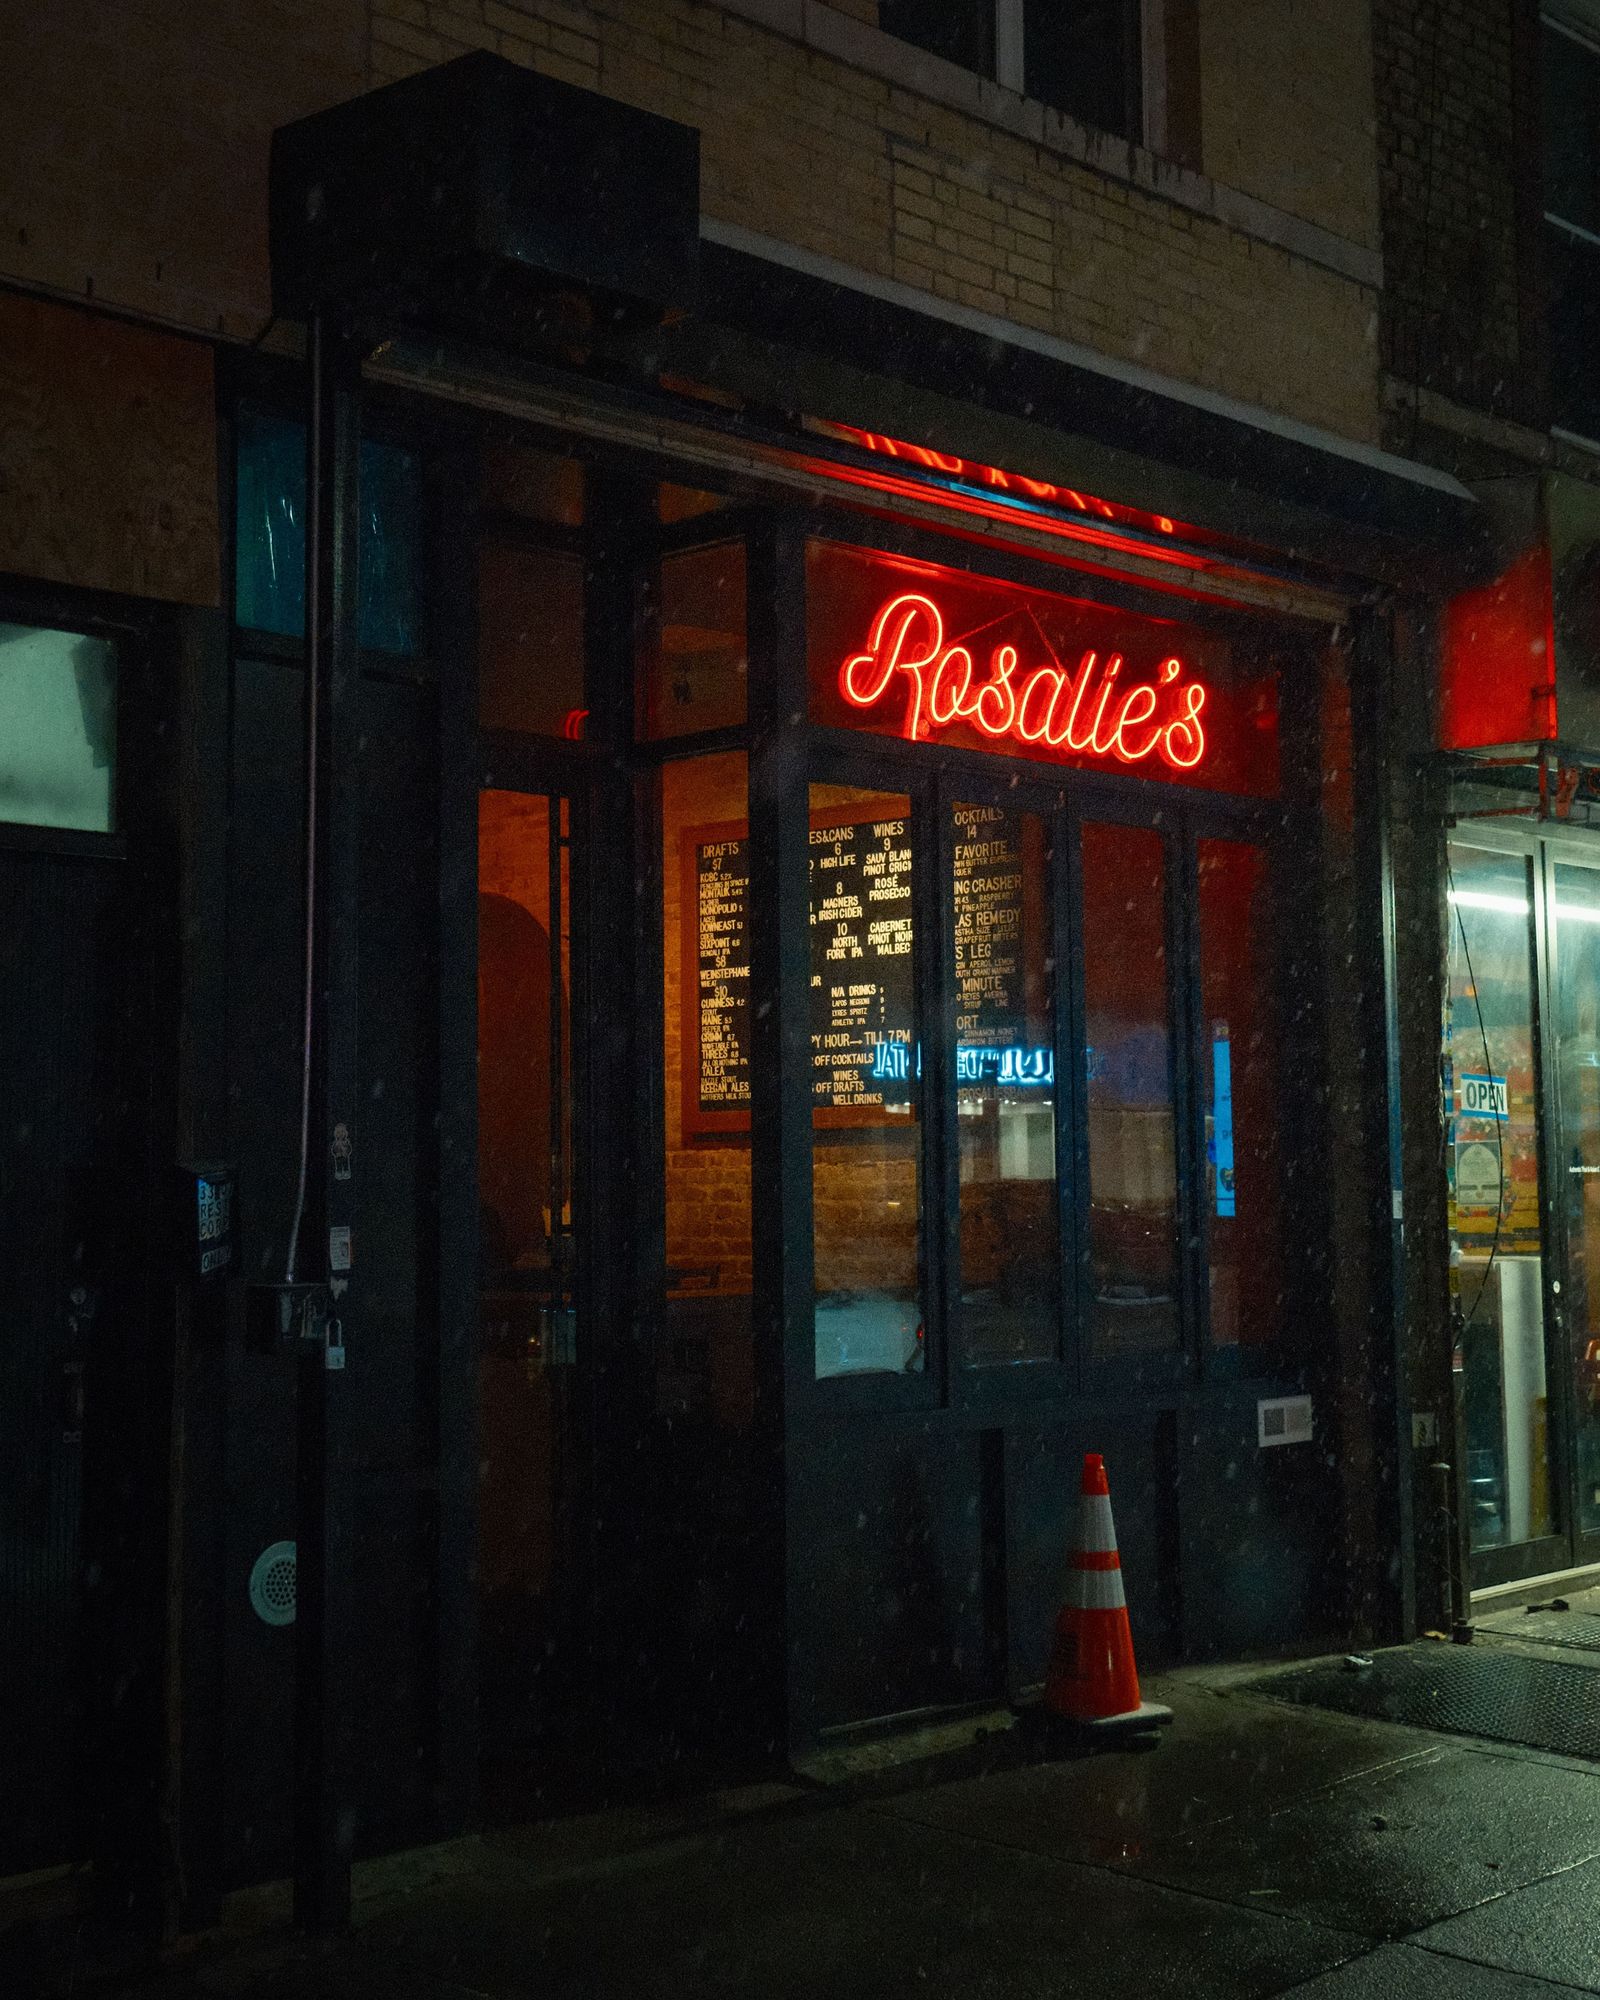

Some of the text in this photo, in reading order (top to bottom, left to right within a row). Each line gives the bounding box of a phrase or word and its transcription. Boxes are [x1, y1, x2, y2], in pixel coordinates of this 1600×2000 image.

[840, 594, 1206, 767] Rosalie's
[955, 806, 1004, 826] OCKTAILS
[874, 822, 903, 838] WINES
[967, 825, 977, 839] 14
[703, 842, 739, 858] DRAFTS
[834, 843, 841, 855] 6
[884, 838, 890, 851] 9
[955, 840, 1008, 860] FAVORITE
[712, 858, 722, 870] $7
[821, 854, 856, 869] HIGH LIFE
[866, 852, 886, 864] SAUV
[863, 863, 886, 876] PINOT
[836, 882, 842, 895] 8
[972, 874, 1021, 893] CRASHER
[700, 888, 730, 899] MONTAUK
[869, 887, 910, 901] PROSECCO
[823, 896, 858, 909] MAGNERS
[962, 902, 995, 912] PINEAPPLE
[700, 903, 737, 916] MONOPOLIO
[819, 906, 862, 921] IRISH CIDER
[976, 908, 1022, 926] REMEDY
[700, 920, 736, 932] DOWNEAST
[837, 923, 848, 936] 10
[870, 919, 912, 933] CABERNET
[700, 937, 730, 949] SIXPOINT
[832, 936, 857, 948] NORTH
[868, 931, 913, 945] PINOT NOIR
[955, 934, 992, 945] GRAPEFRUIT
[827, 947, 863, 960] FORK IPA
[877, 943, 911, 955] MALBEC
[970, 944, 992, 959] LEG
[716, 956, 726, 968] $8
[969, 959, 992, 968] APEROL
[962, 976, 1002, 992] MINUTE
[714, 986, 728, 998] $10
[831, 987, 844, 998] N/A
[849, 984, 876, 996] DRINKS
[701, 997, 734, 1008] GUINNESS
[702, 1014, 722, 1025] MAINE
[825, 1033, 850, 1048] HOUR
[864, 1031, 883, 1045] TILL
[888, 1030, 894, 1043] 7
[896, 1029, 910, 1043] PM
[702, 1049, 728, 1059] THREES
[815, 1053, 874, 1066] OFF COCKTAILS
[702, 1066, 725, 1076] TALEA
[833, 1070, 859, 1081] WINES
[701, 1082, 749, 1093] KEEGAN ALES
[816, 1080, 865, 1093] OFF DRAFTS
[833, 1093, 883, 1105] WELL DRINKS
[1466, 1082, 1505, 1112] OPEN
